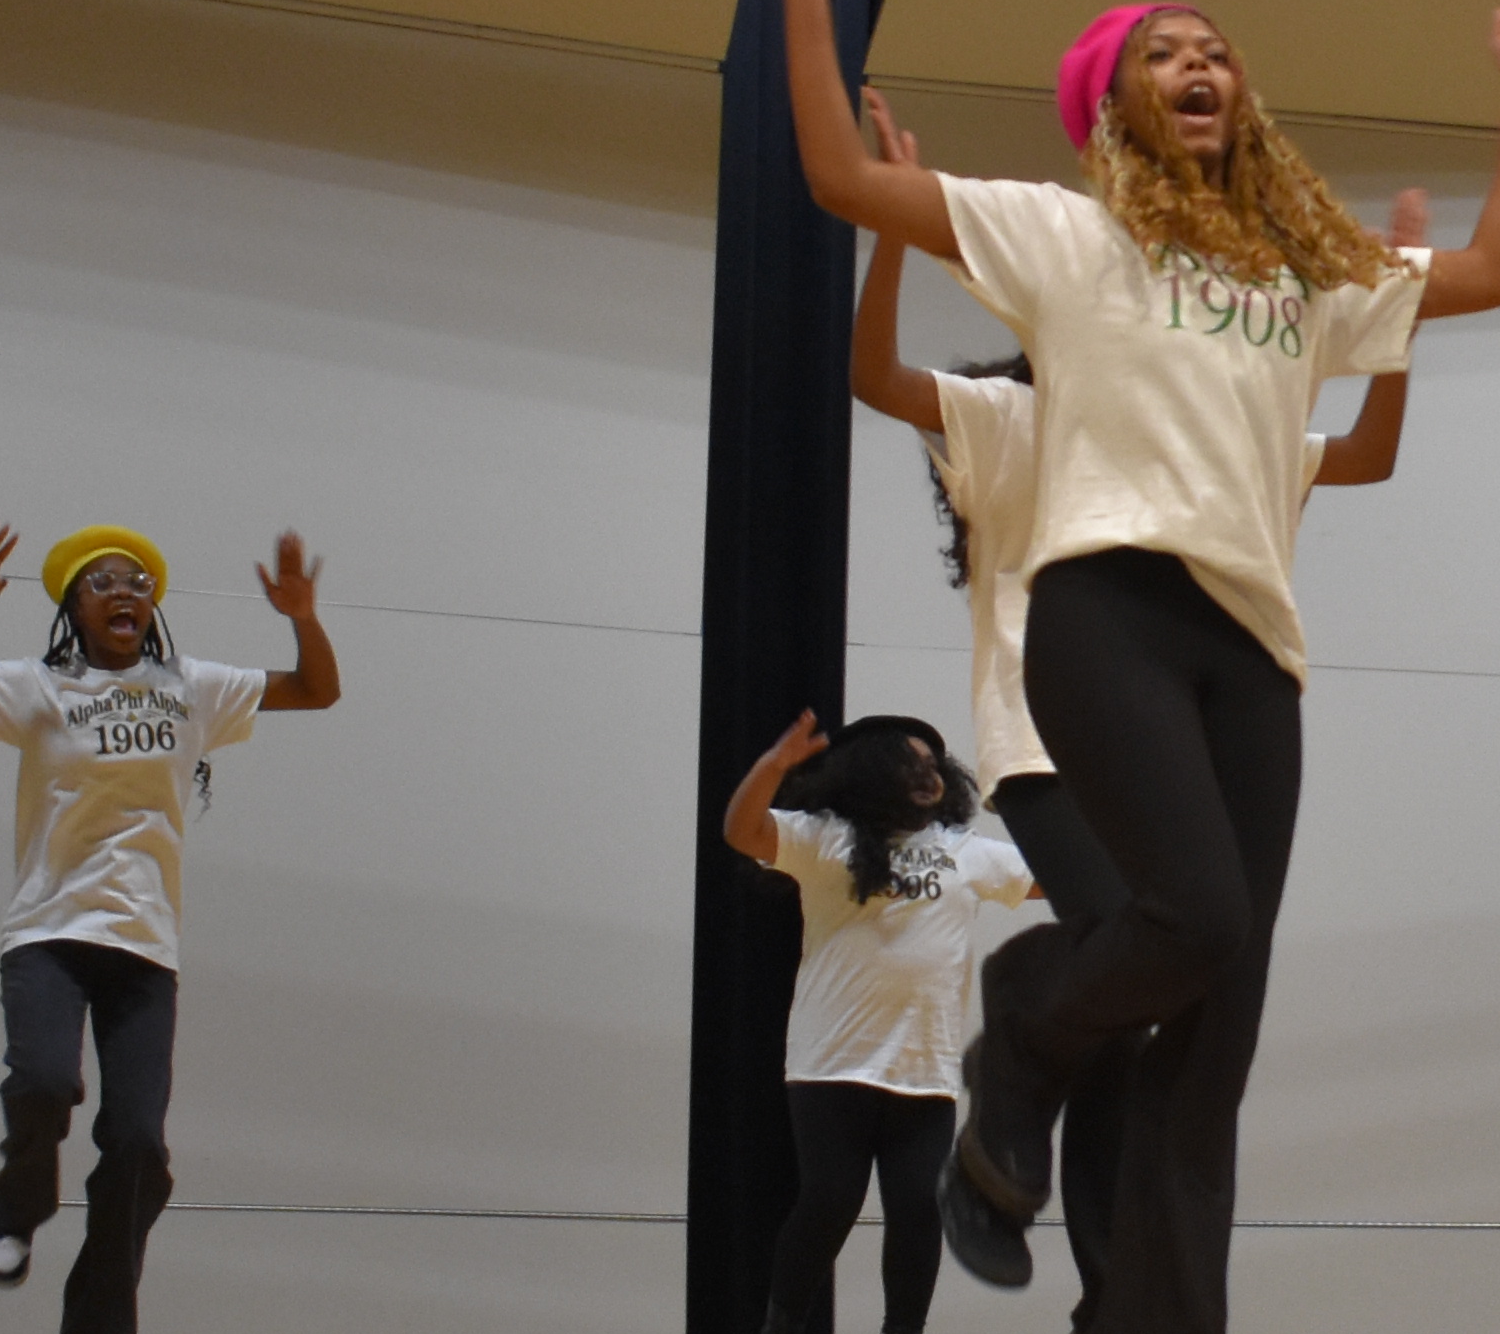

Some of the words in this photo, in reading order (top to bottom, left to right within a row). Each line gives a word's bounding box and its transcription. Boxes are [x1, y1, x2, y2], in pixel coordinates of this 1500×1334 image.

[1161, 273, 1302, 358] 1908
[67, 696, 113, 727] Alpha
[111, 688, 144, 710] Phi
[148, 689, 190, 721] Alpha
[94, 720, 176, 755] 1906
